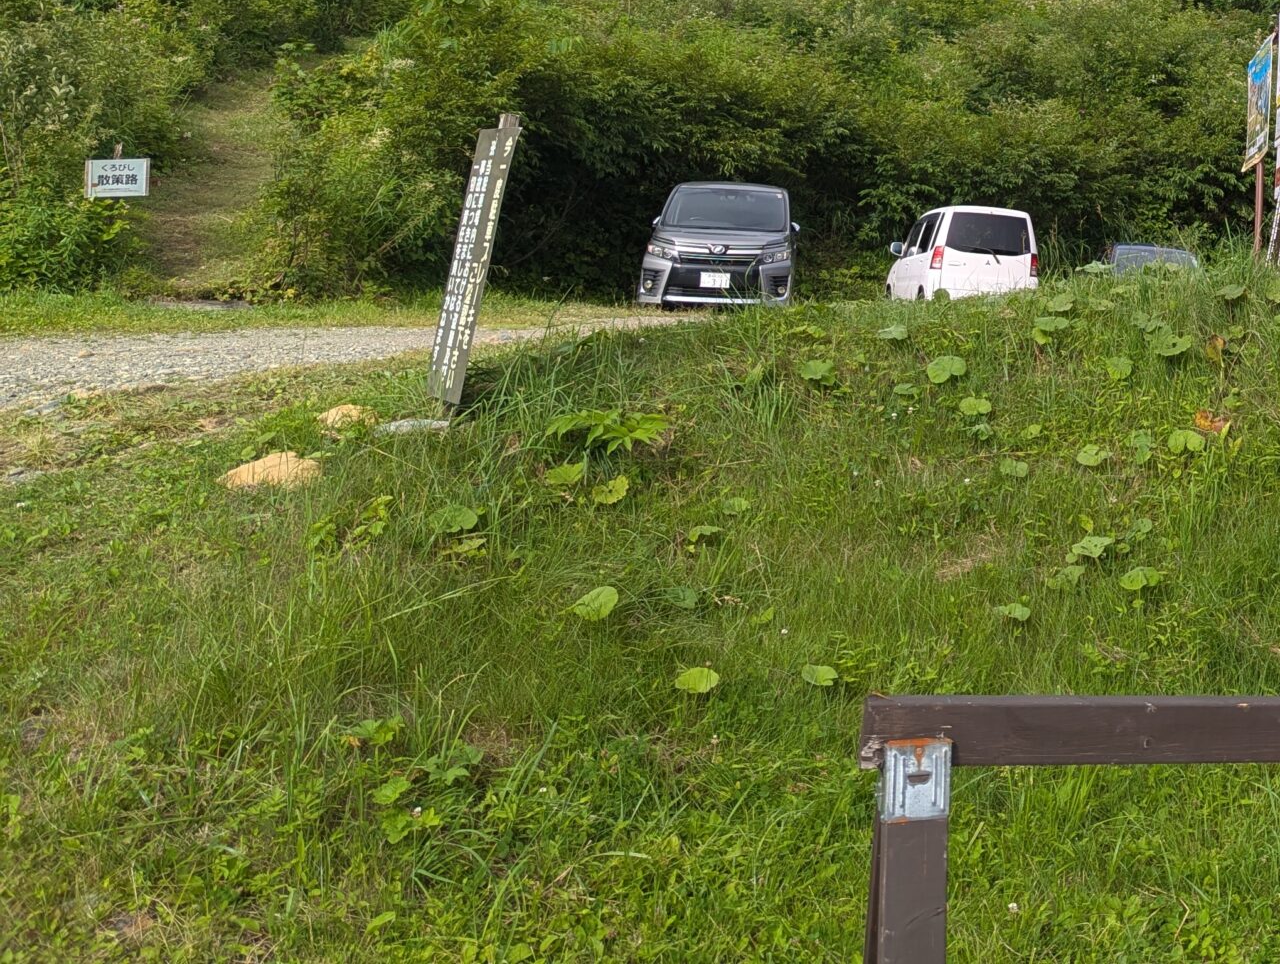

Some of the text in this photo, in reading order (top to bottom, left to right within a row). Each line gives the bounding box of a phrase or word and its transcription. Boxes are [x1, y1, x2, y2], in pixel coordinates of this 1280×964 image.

[101, 163, 136, 172] くろびし
[97, 174, 139, 186] 散策路
